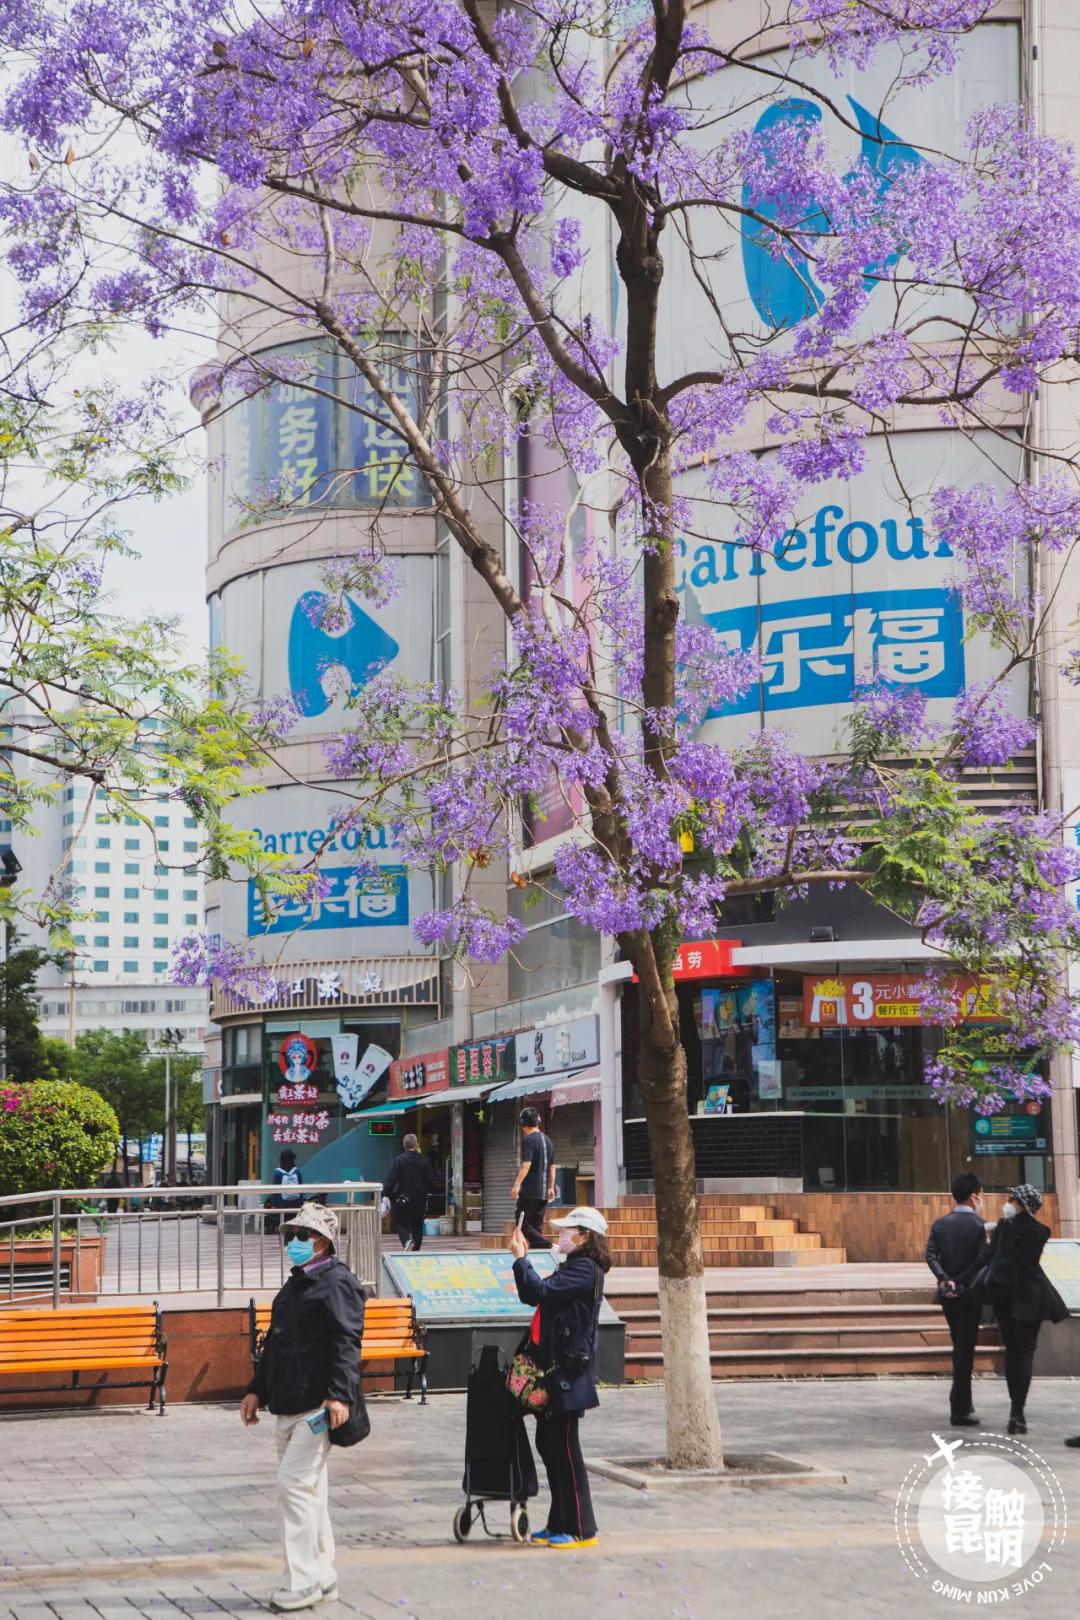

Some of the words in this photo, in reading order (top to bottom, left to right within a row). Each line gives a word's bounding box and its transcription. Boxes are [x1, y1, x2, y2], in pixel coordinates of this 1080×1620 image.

[265, 970, 383, 1000] 王茶姬
[852, 981, 874, 1020] 3
